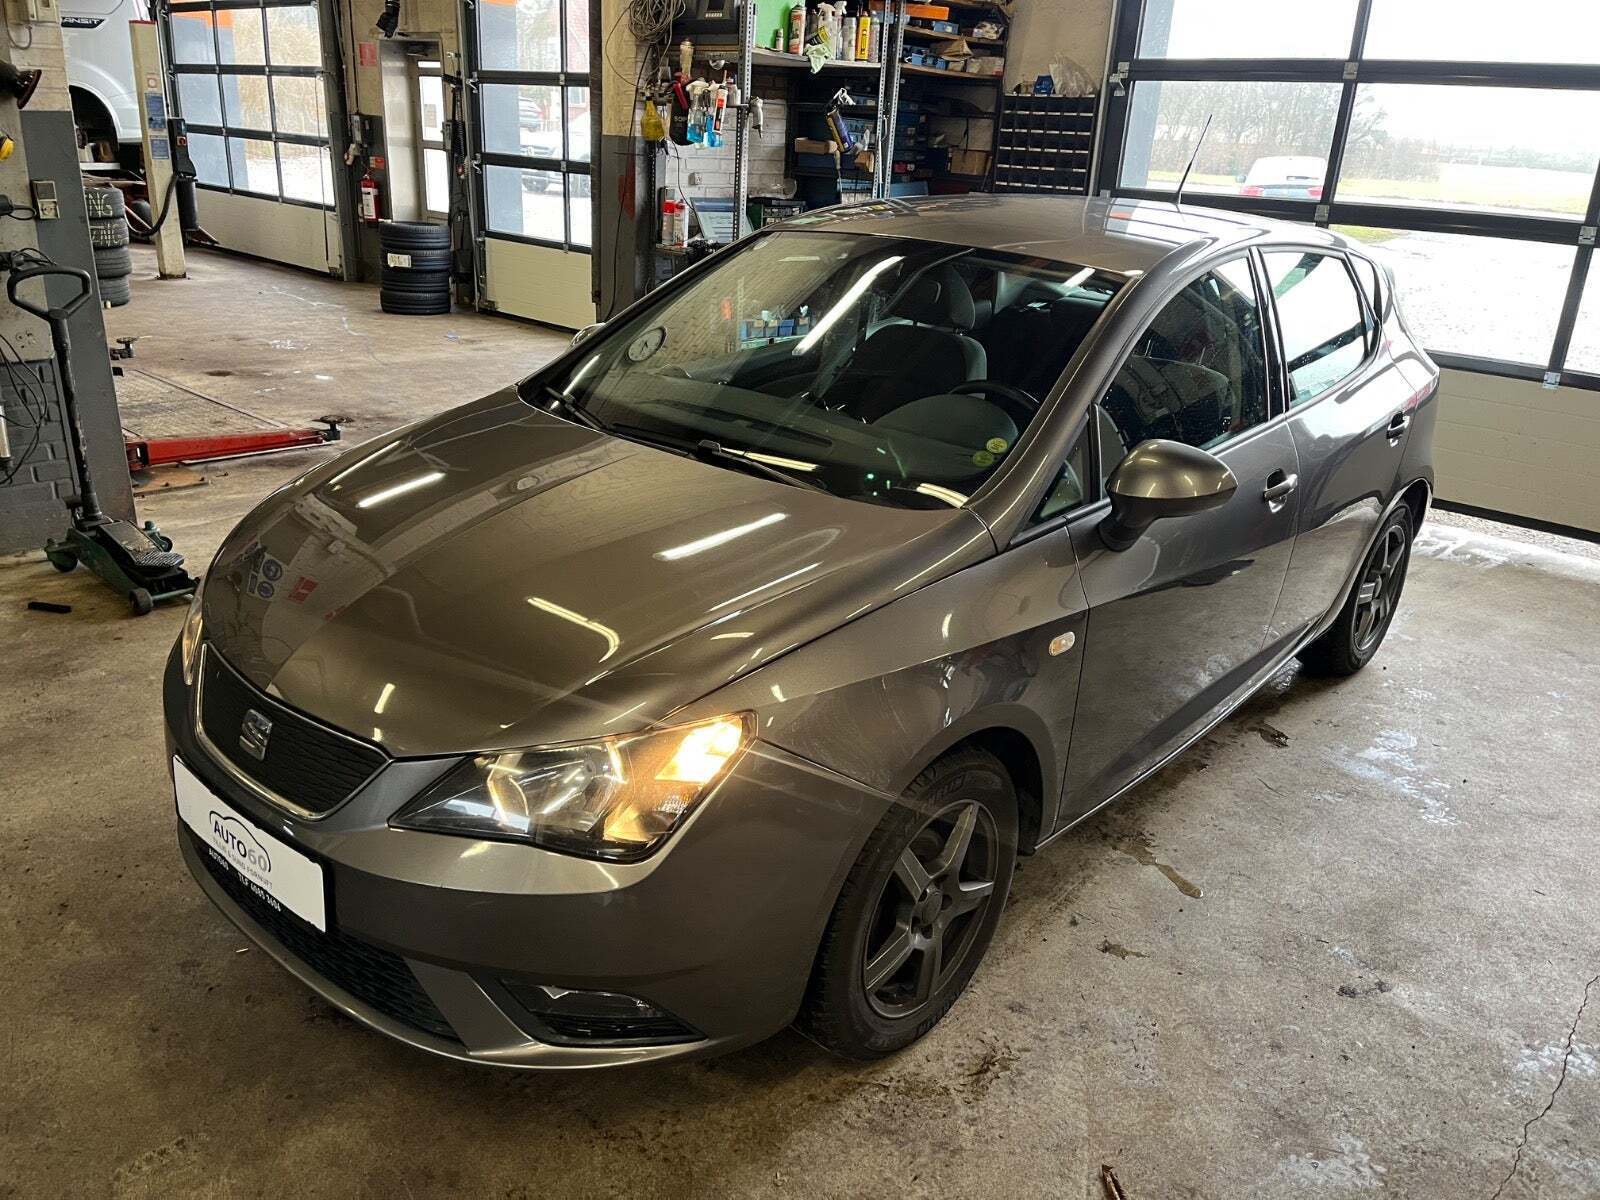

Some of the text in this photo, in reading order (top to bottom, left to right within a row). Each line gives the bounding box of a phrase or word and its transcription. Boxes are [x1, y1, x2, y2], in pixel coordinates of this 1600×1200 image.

[62, 17, 101, 25] ANSIT
[85, 192, 113, 217] NG
[214, 820, 268, 872] AUTO60
